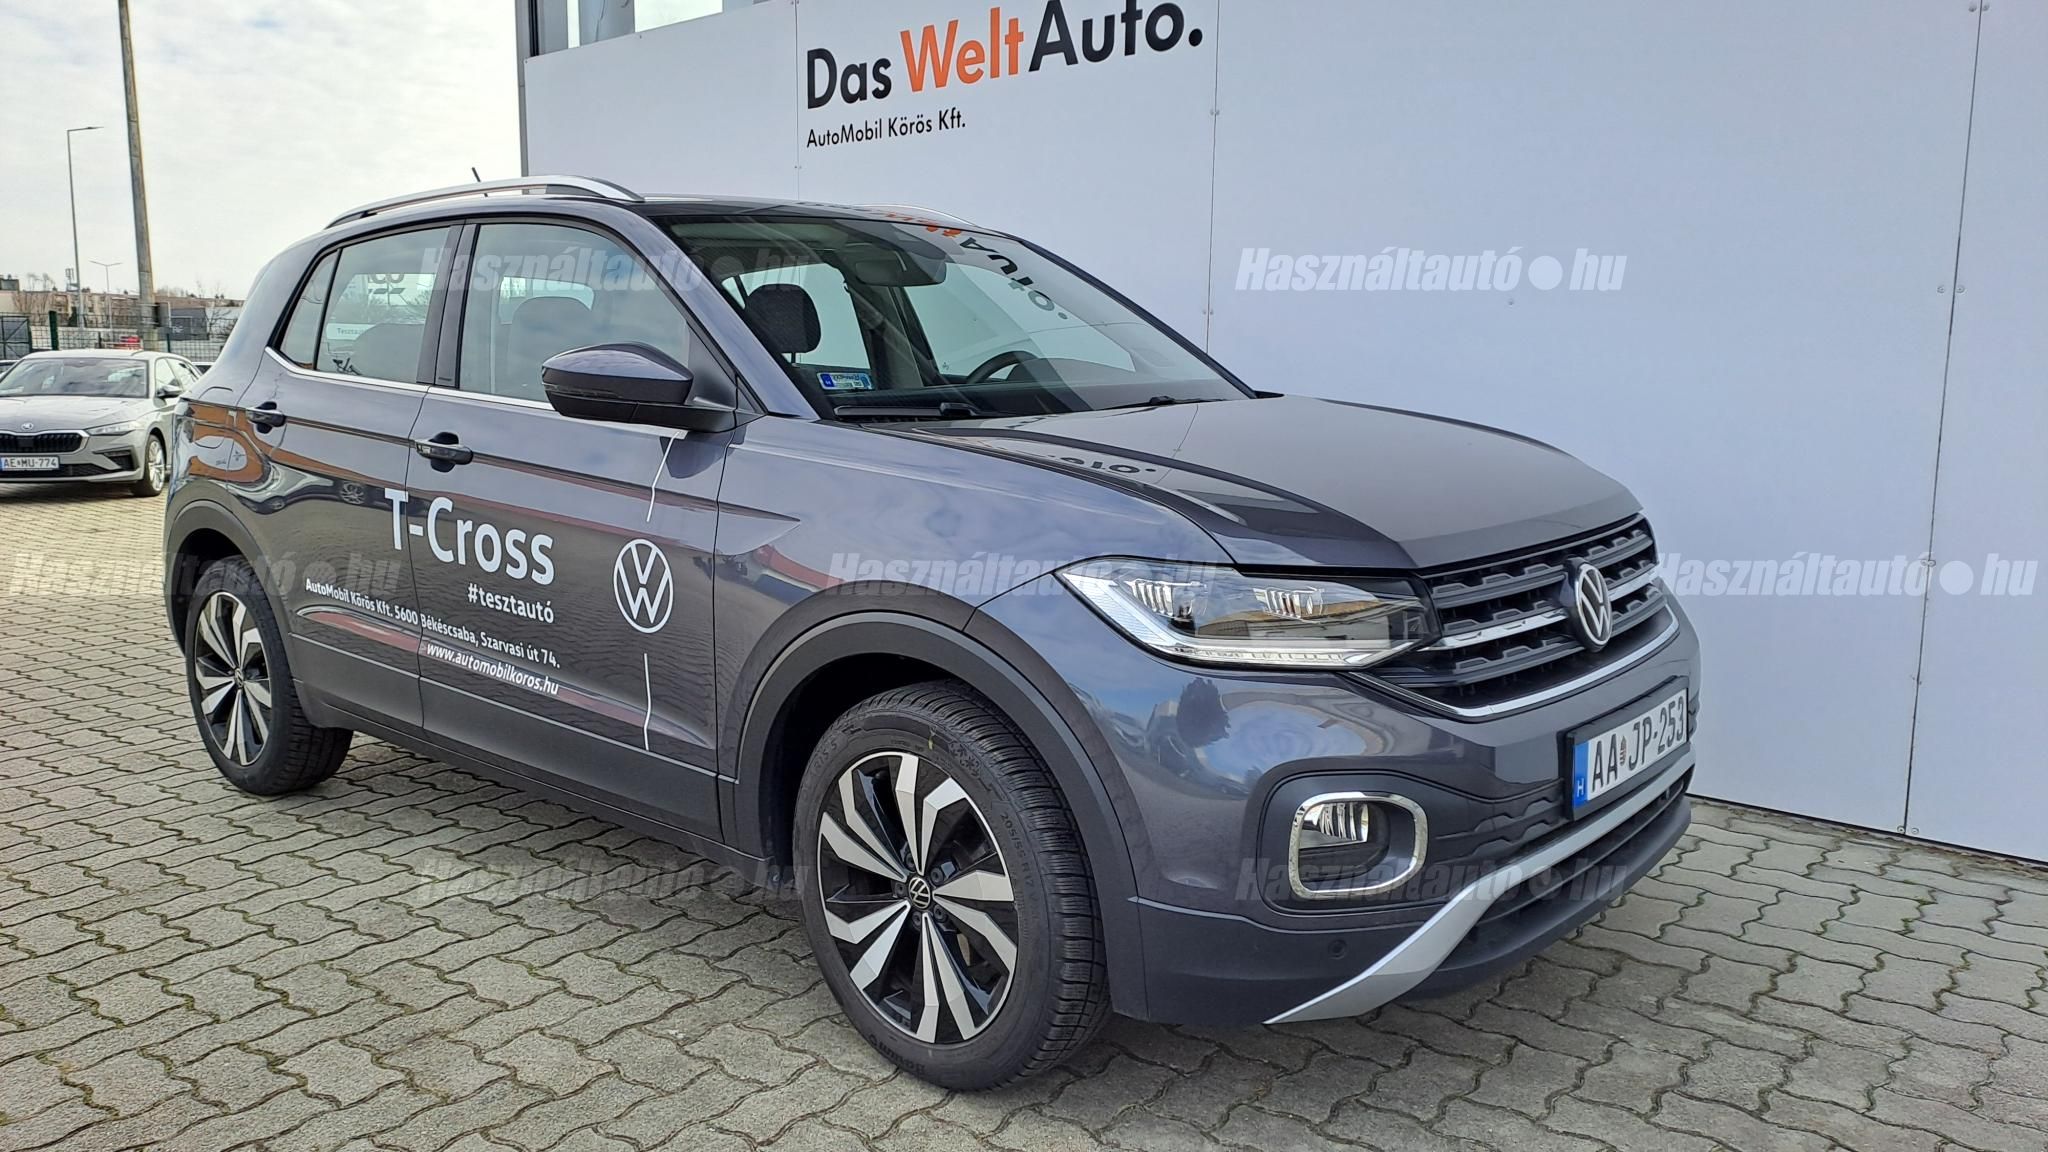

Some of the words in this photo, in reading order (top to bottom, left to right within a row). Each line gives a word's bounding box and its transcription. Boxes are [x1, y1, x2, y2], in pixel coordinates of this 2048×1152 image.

[807, 48, 892, 109] Das
[806, 119, 883, 149] AutoMobil
[887, 112, 933, 138] Körös
[938, 107, 966, 131] Kft.
[384, 487, 555, 586] T-Cross
[305, 578, 349, 603] AutoMobil
[350, 591, 376, 611] Körös
[376, 599, 393, 617] Kft.
[395, 605, 419, 625] 5600
[420, 613, 479, 648] Békéscsaba,
[480, 631, 525, 658] Szarvasi
[526, 645, 540, 662] út
[541, 648, 561, 669] 74.
[467, 582, 554, 624] #tesztautó
[426, 643, 559, 695] www.automobilkoros.hu
[1592, 733, 1618, 794] AA
[1628, 696, 1684, 772] JP-253
